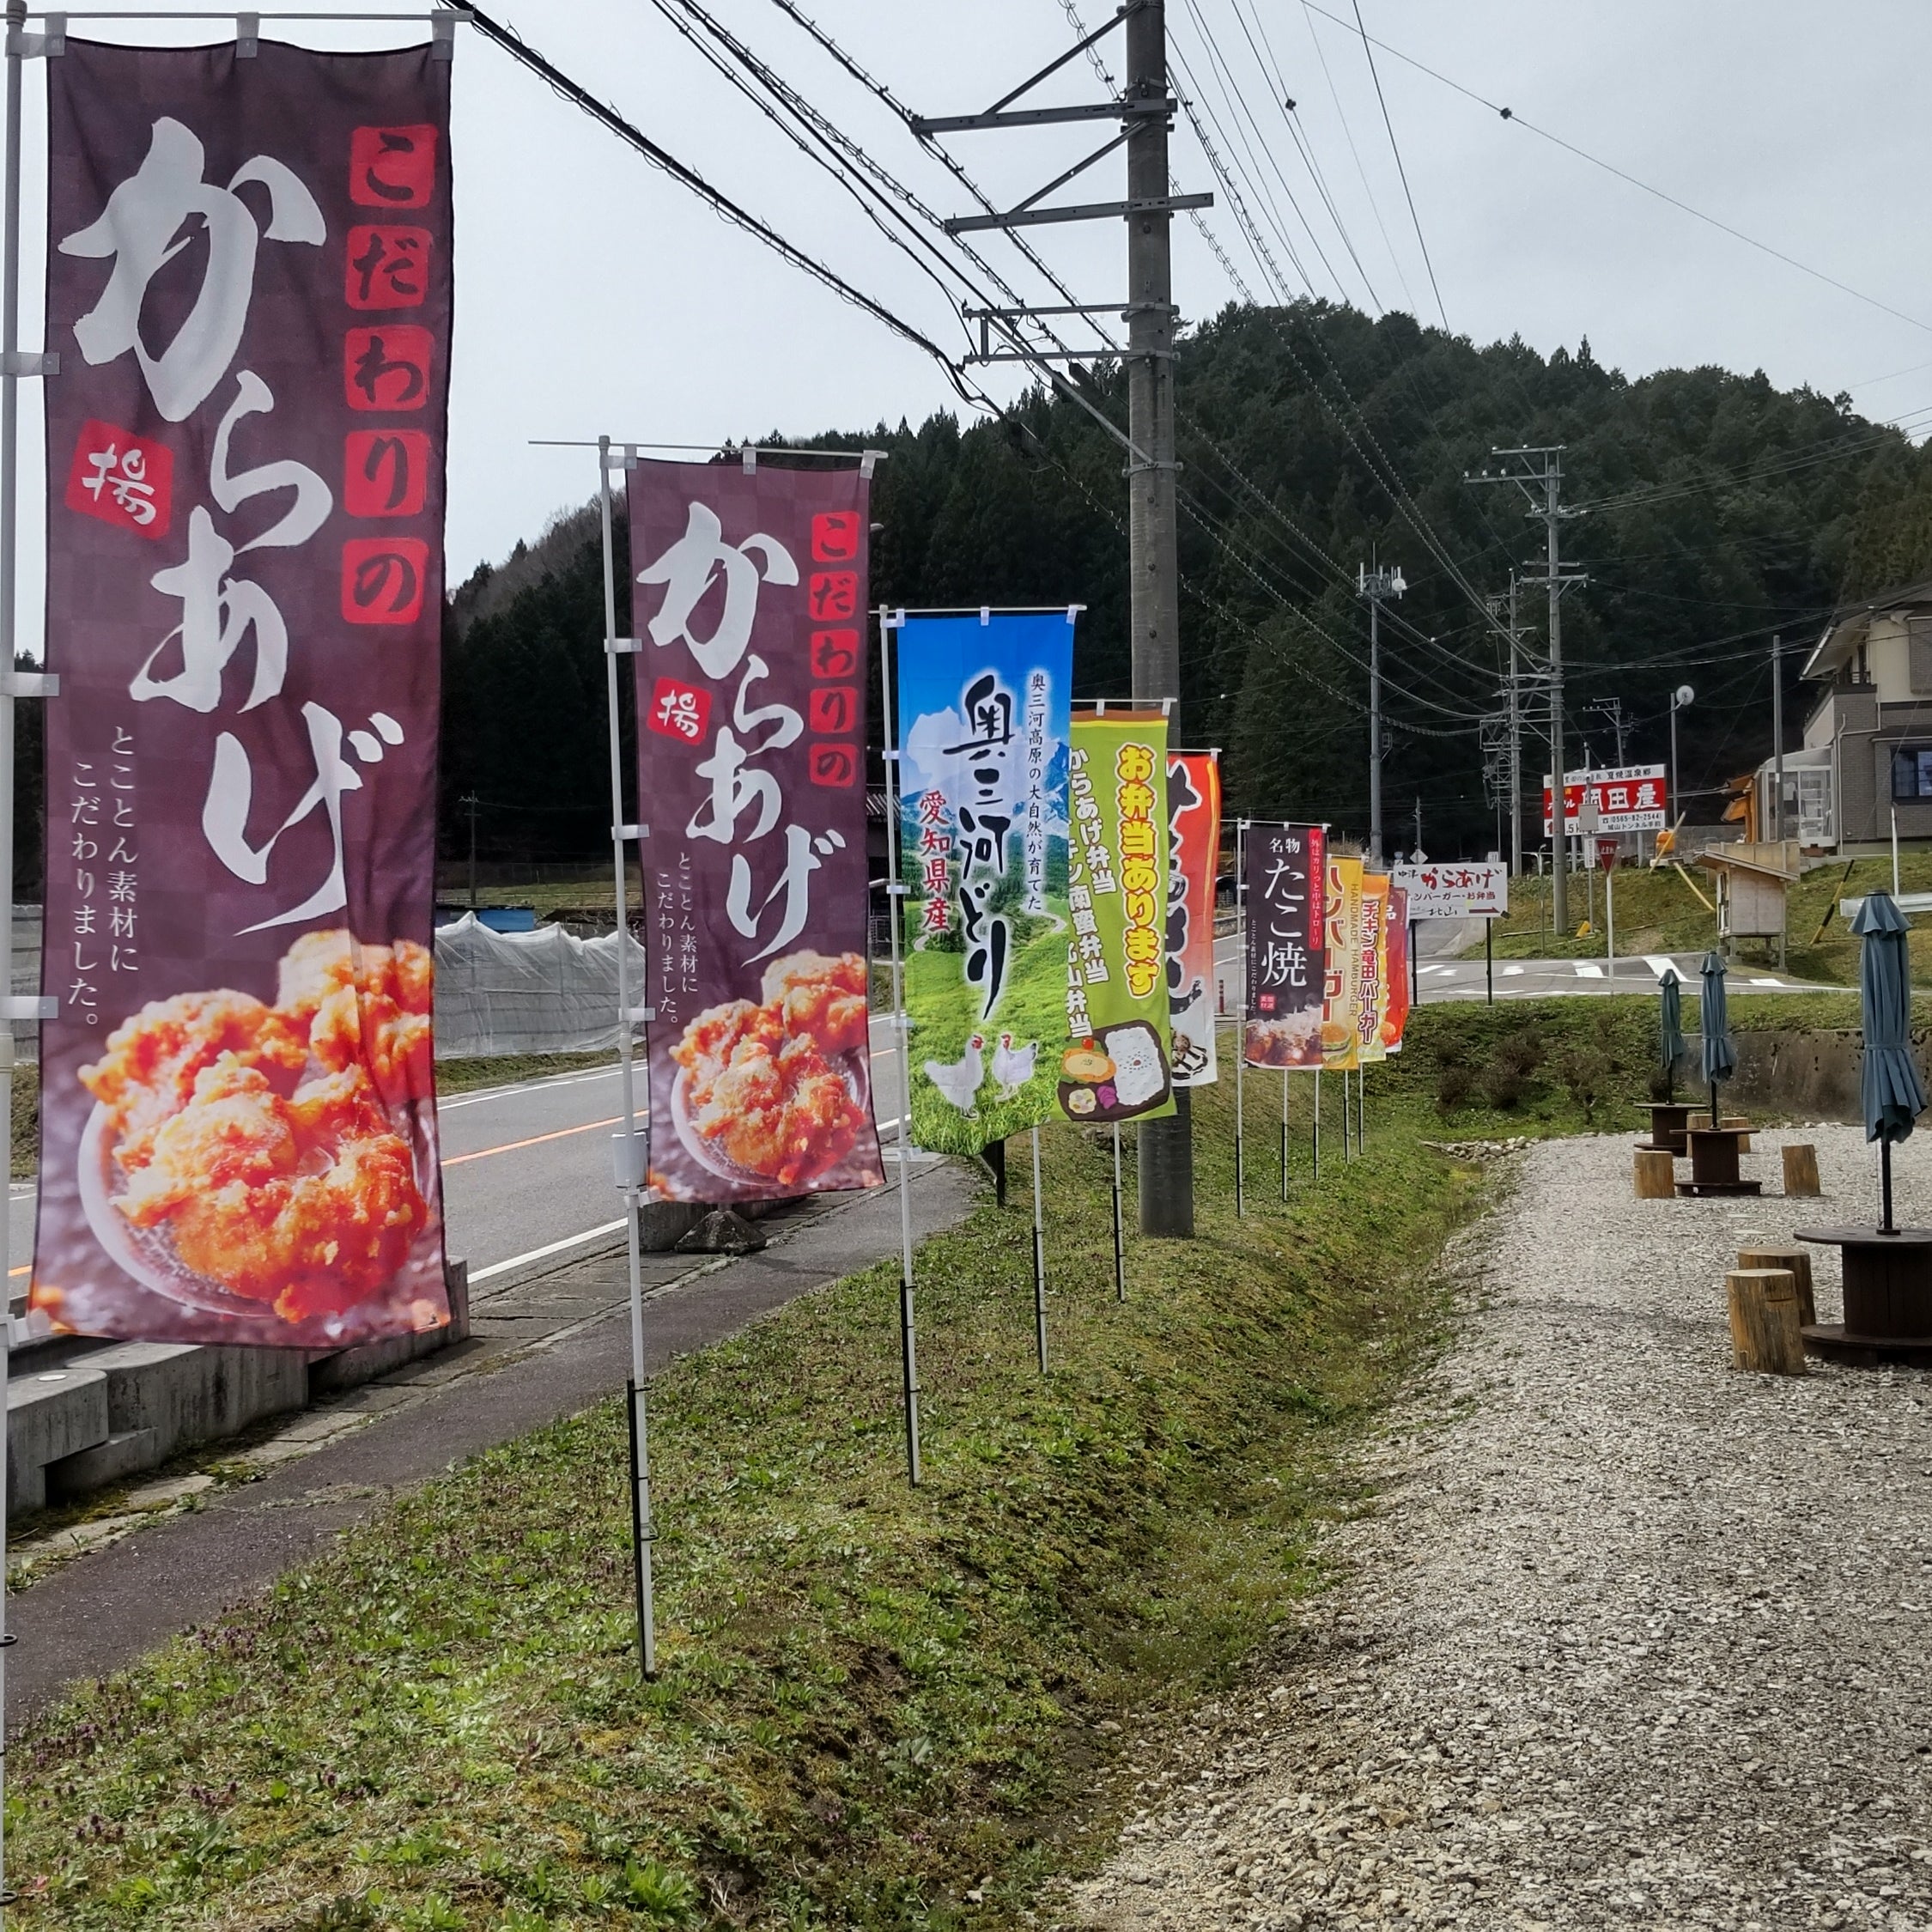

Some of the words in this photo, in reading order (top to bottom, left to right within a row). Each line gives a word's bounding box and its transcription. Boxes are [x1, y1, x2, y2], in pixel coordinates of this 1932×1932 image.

[352, 133, 422, 613] こだわりの
[57, 115, 405, 937] からあげ
[635, 501, 847, 969] からあげ
[813, 516, 854, 781] こだわりの
[107, 726, 139, 973] とことん素材に
[919, 789, 951, 933] 愛知県産
[942, 674, 1016, 1021] 奥三河どり
[1027, 672, 1047, 911] 奥三河高原の大自然が育てた
[1069, 748, 1116, 895] からあげ弁当
[1117, 743, 1160, 999] お弁当あります
[1269, 837, 1300, 854] 名物
[68, 762, 99, 1026] こだわりました。
[656, 872, 679, 1024] こだわりました。
[677, 853, 699, 993] とことん素材に
[1261, 858, 1309, 987] たこ焼
[1348, 949, 1358, 1017] HAMBURGER
[1349, 884, 1358, 944] HANDMADE
[1359, 902, 1378, 1043] チキン竜田バーガー
